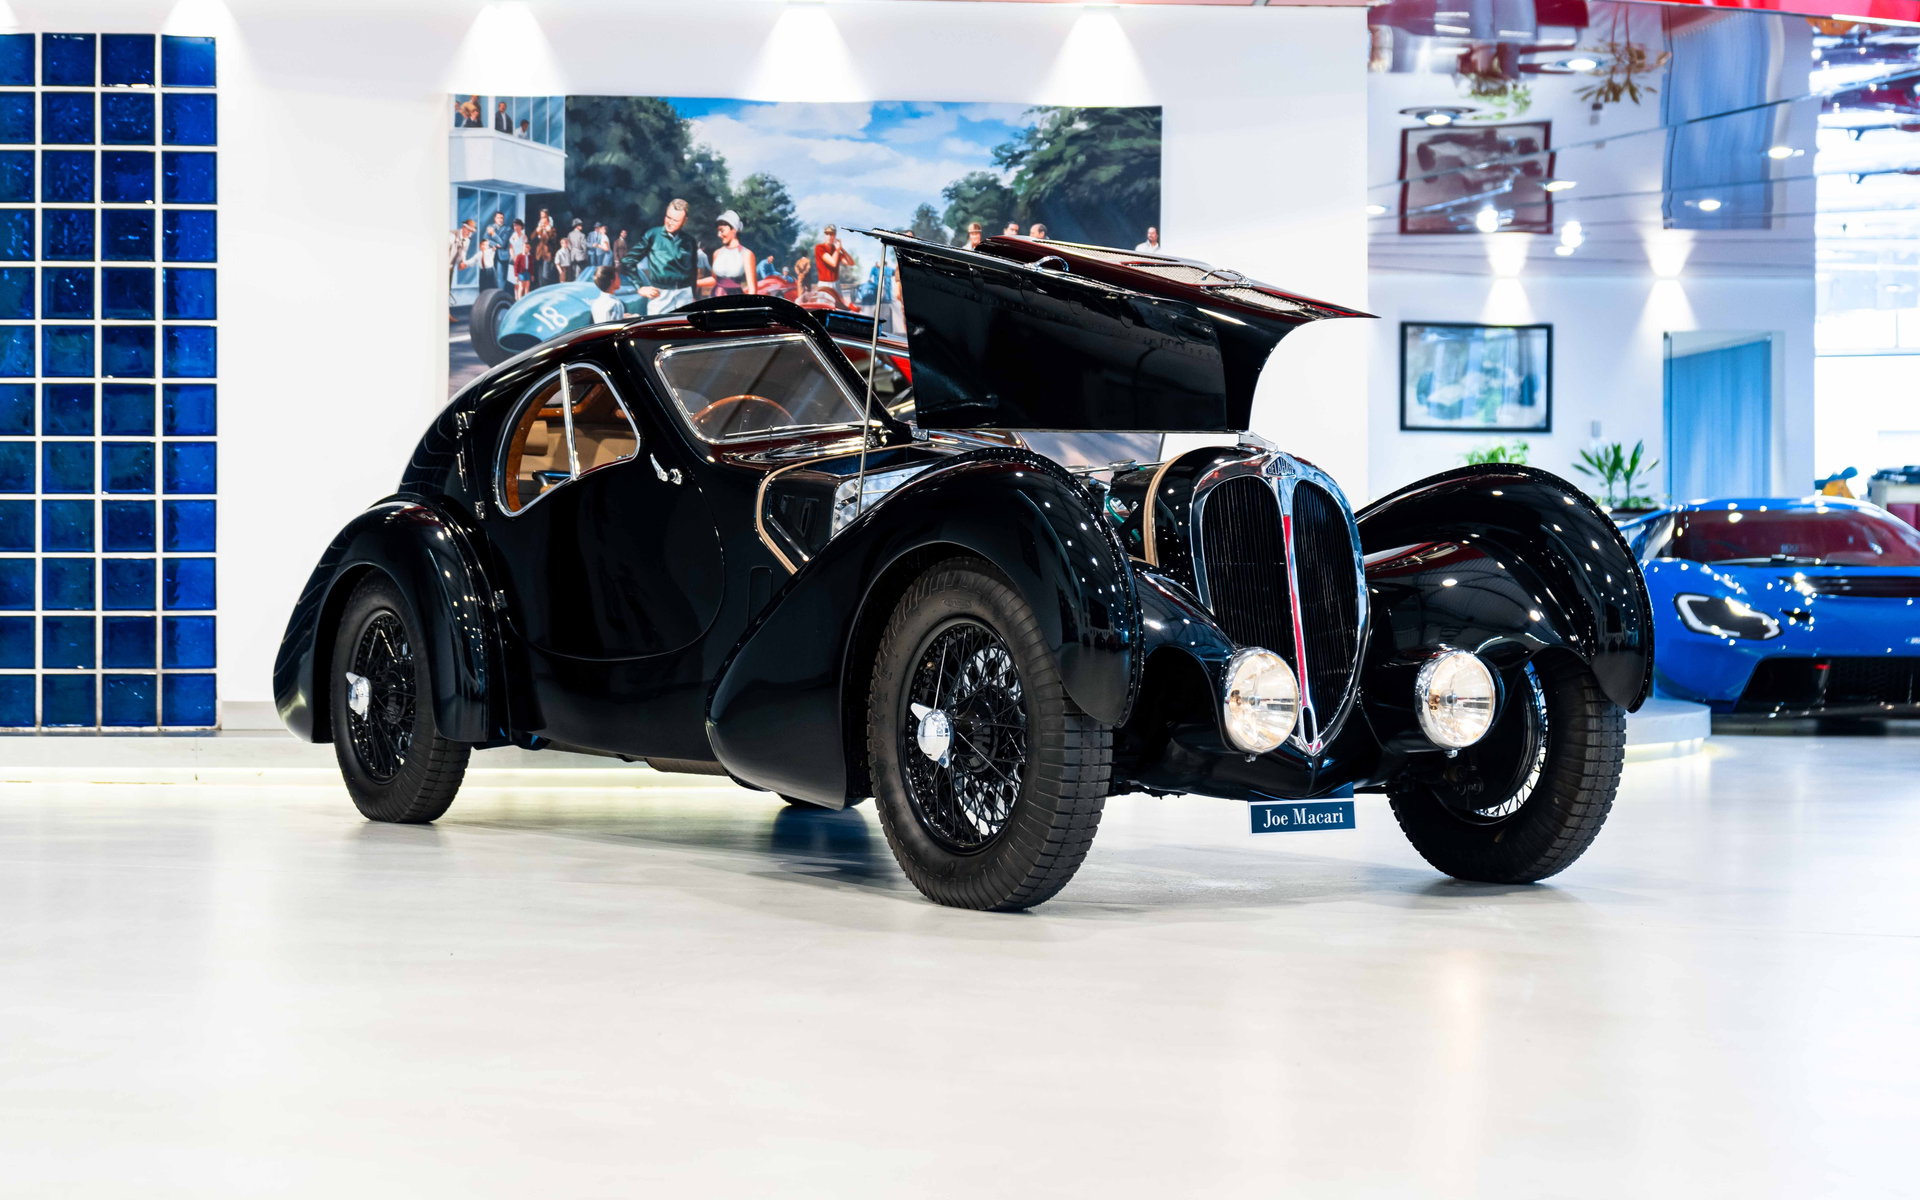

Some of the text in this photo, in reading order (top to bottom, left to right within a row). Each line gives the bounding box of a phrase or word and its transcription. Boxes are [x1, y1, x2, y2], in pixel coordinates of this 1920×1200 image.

[532, 306, 569, 331] 18
[1263, 807, 1344, 828] Joe Macari
